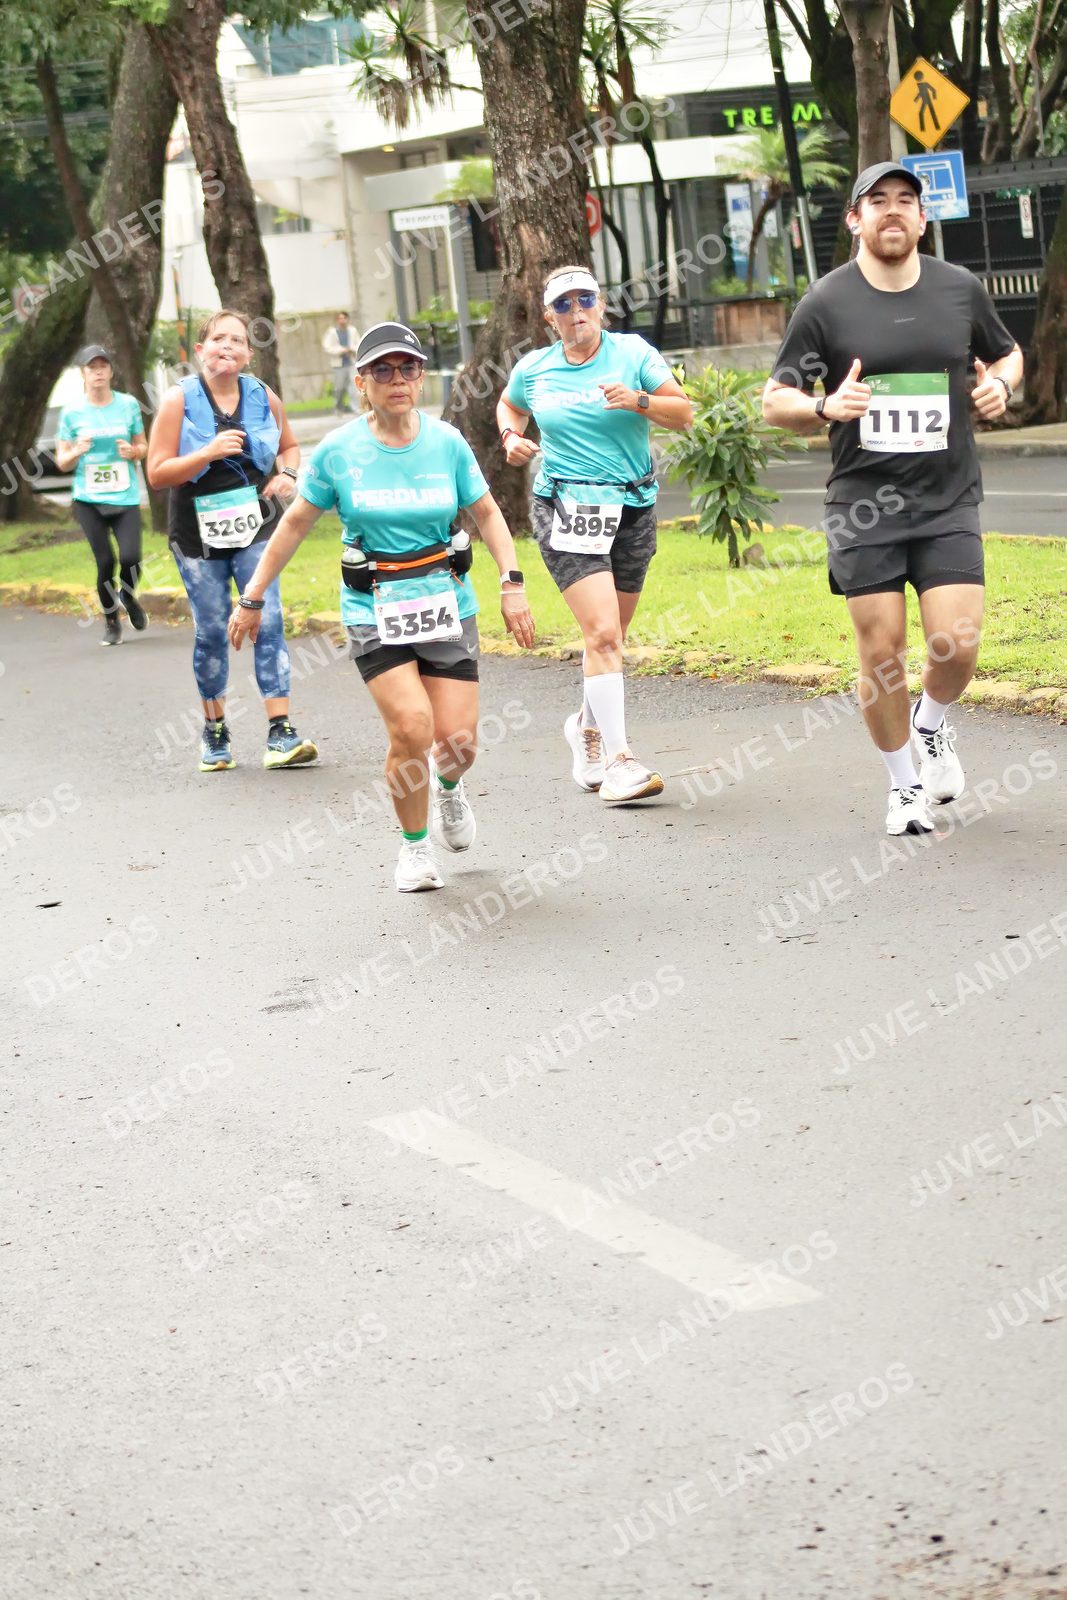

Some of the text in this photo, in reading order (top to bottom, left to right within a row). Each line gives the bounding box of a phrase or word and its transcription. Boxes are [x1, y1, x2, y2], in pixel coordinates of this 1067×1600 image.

[869, 410, 943, 433] 1112
[93, 470, 119, 483] 291
[351, 487, 454, 508] PERDURA
[205, 513, 258, 538] 3260
[384, 606, 454, 639] 5354
